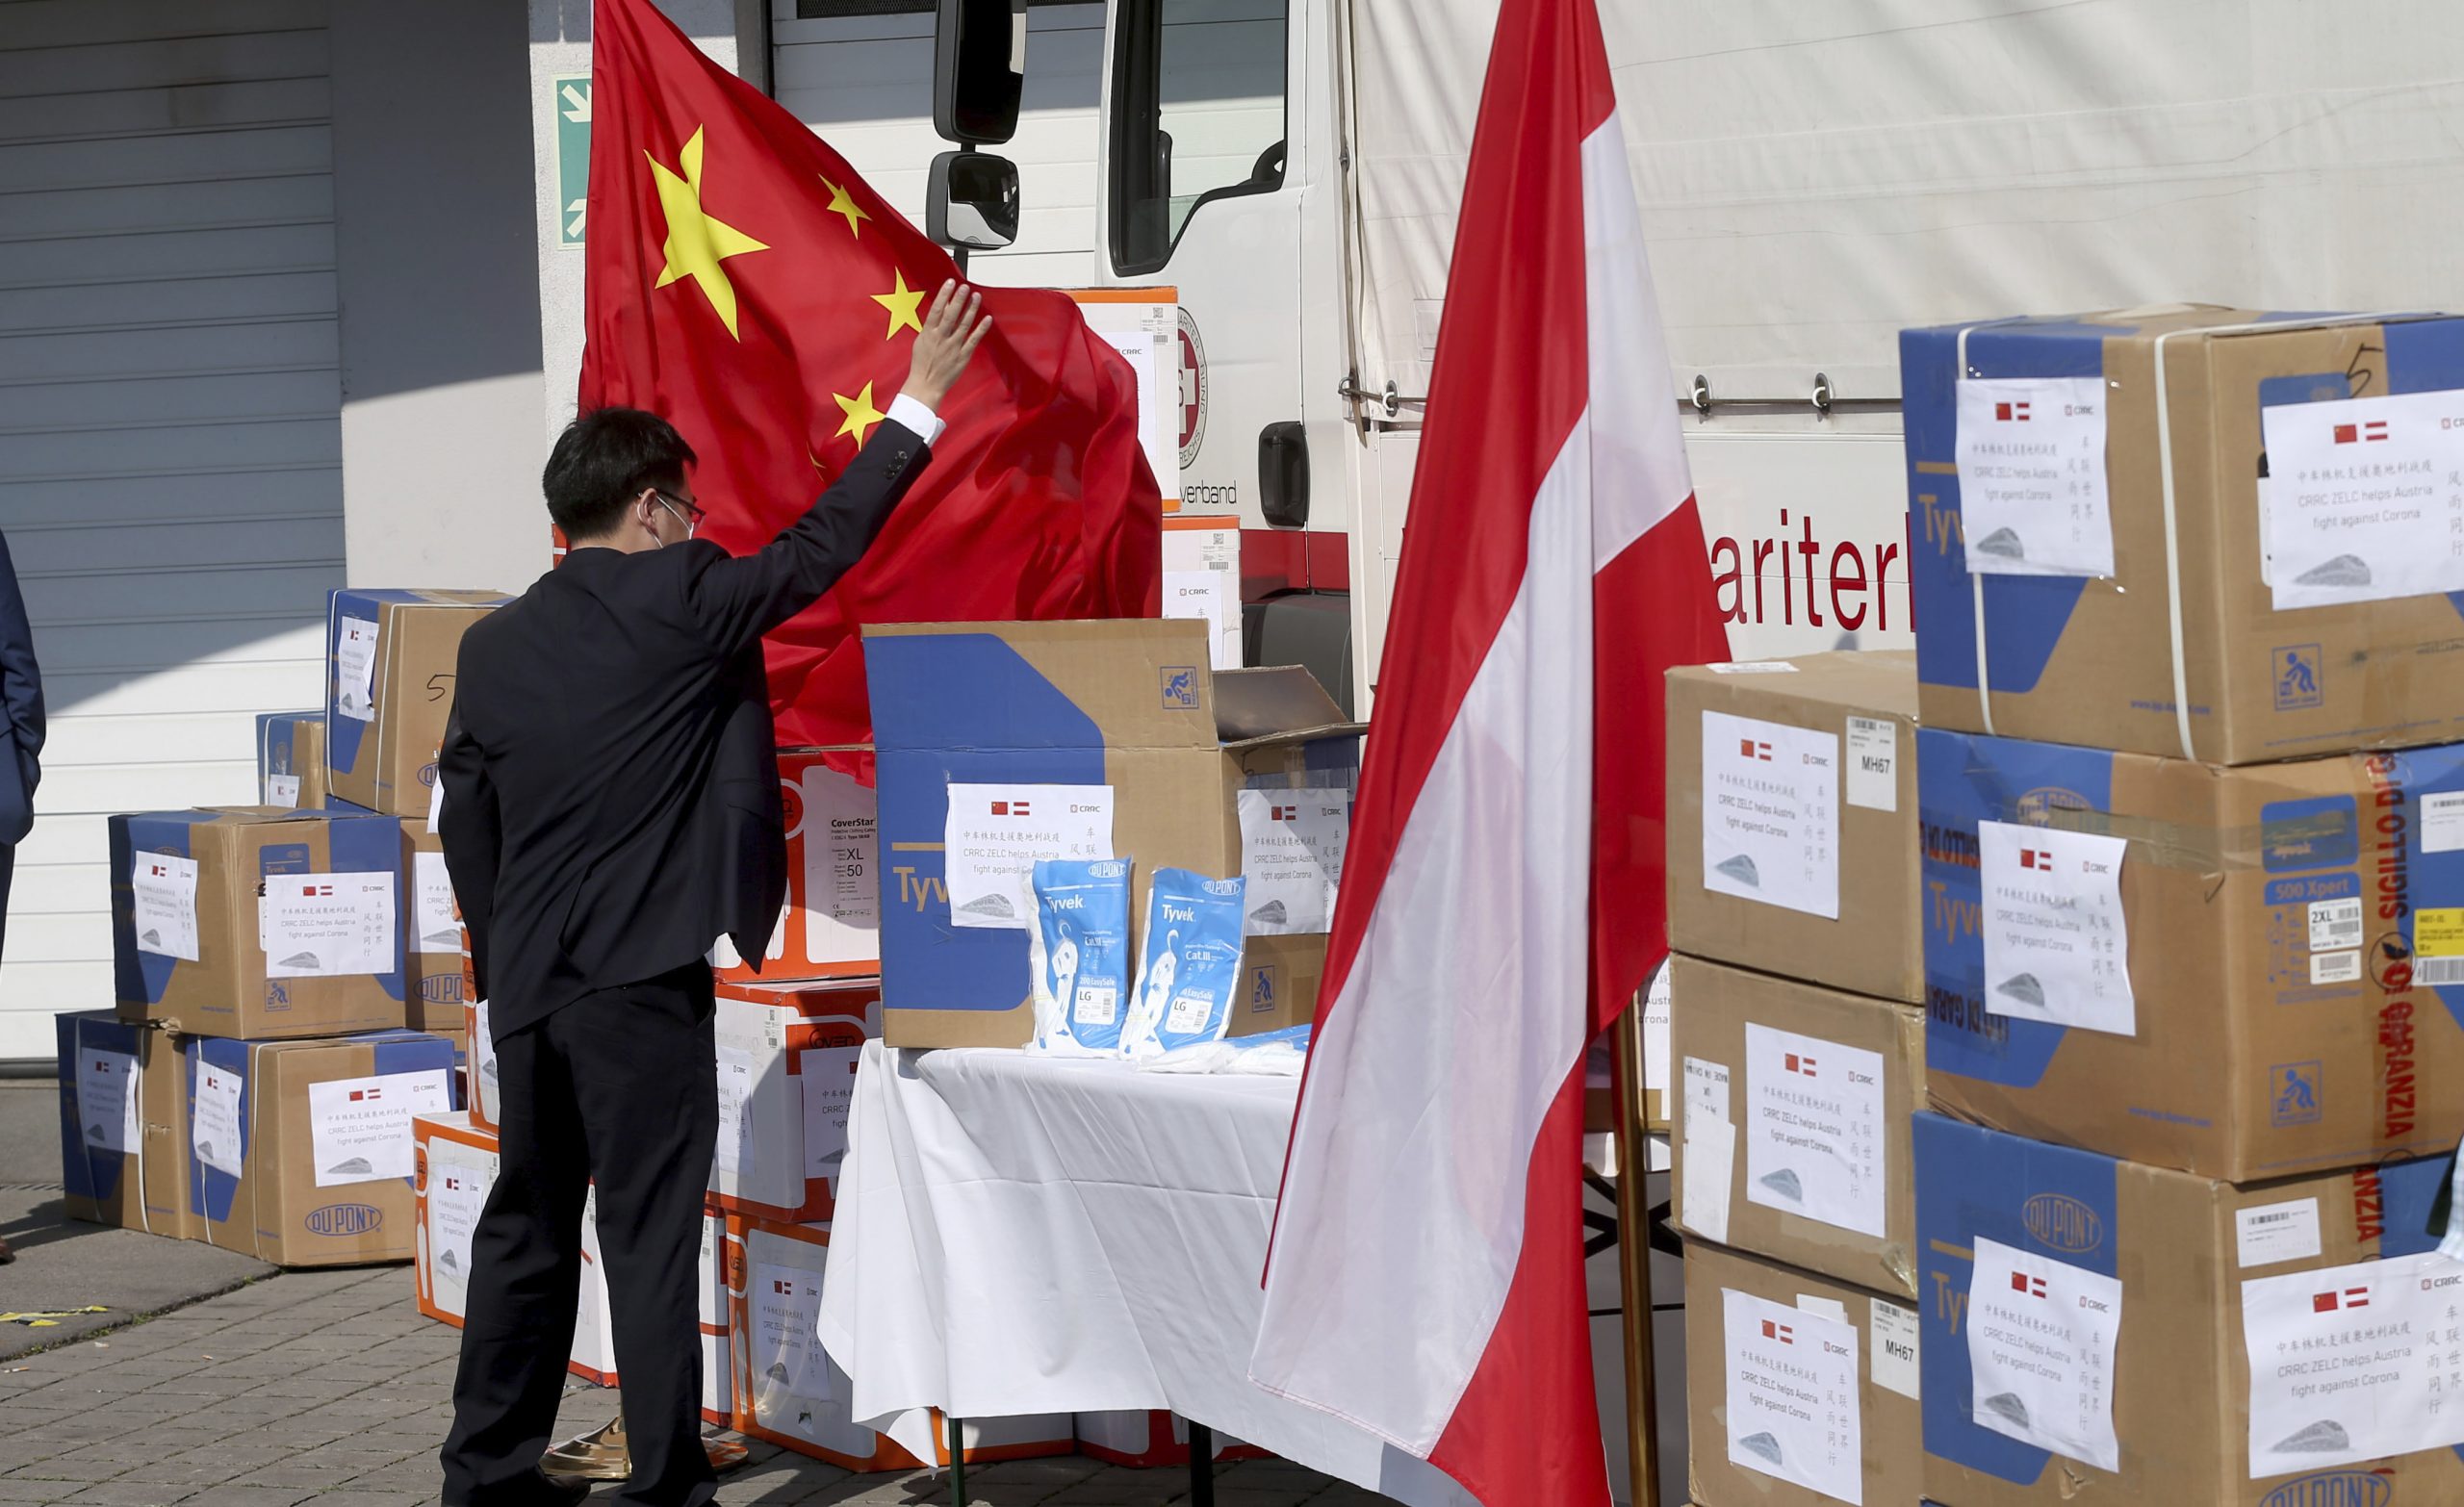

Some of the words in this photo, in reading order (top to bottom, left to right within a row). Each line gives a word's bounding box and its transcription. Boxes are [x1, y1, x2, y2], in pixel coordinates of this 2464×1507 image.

[2346, 343, 2384, 399] 5
[1180, 480, 1237, 504] verband
[2298, 494, 2329, 508] CRRC
[2332, 491, 2359, 506] ZELC
[2395, 485, 2433, 498] Austria
[1710, 507, 1915, 633] ariter
[426, 674, 456, 702] 5
[1861, 754, 1891, 775] MH67
[1079, 805, 1101, 813] CRRC
[832, 818, 874, 828] CoverStar
[846, 848, 864, 860] XL
[963, 848, 985, 857] CRRC
[987, 848, 1007, 858] ZELC
[1008, 849, 1030, 860] helps
[1031, 849, 1059, 859] Austria
[1254, 856, 1270, 864] CRRC
[1270, 856, 1283, 864] ZELC
[1298, 855, 1318, 863] Austria
[847, 864, 863, 877] 50
[972, 865, 990, 876] fight
[991, 865, 1019, 876] against
[1102, 862, 1125, 877] PONT
[2376, 814, 2408, 920] SIGILLO
[1215, 881, 1239, 895] PONT
[2275, 882, 2305, 899] 500
[2307, 879, 2348, 899] Xpert
[1044, 894, 1084, 913] Tyvek
[1162, 904, 1194, 923] Tyvek
[2312, 910, 2333, 924] 2XL
[421, 980, 440, 1001] DU
[1079, 991, 1091, 1001] LG
[1173, 1000, 1187, 1011] LG
[822, 1105, 844, 1114] CRRC
[312, 1209, 332, 1233] DU
[334, 1206, 376, 1233] PONT
[2028, 1199, 2050, 1239] DU
[2053, 1199, 2096, 1247] PONT
[2433, 1275, 2463, 1288] CRRC
[1885, 1338, 1915, 1364] MH67
[2277, 1362, 2309, 1378] CRRC
[2310, 1357, 2339, 1373] ZELC
[2342, 1353, 2372, 1370] helps
[2374, 1346, 2412, 1363] Austria
[1741, 1370, 1758, 1386] CRRC
[1759, 1375, 1776, 1391] ZELC
[1796, 1389, 1818, 1405] Austria
[2291, 1382, 2316, 1398] fight
[2318, 1378, 2359, 1394] against
[2361, 1370, 2400, 1386] Corona
